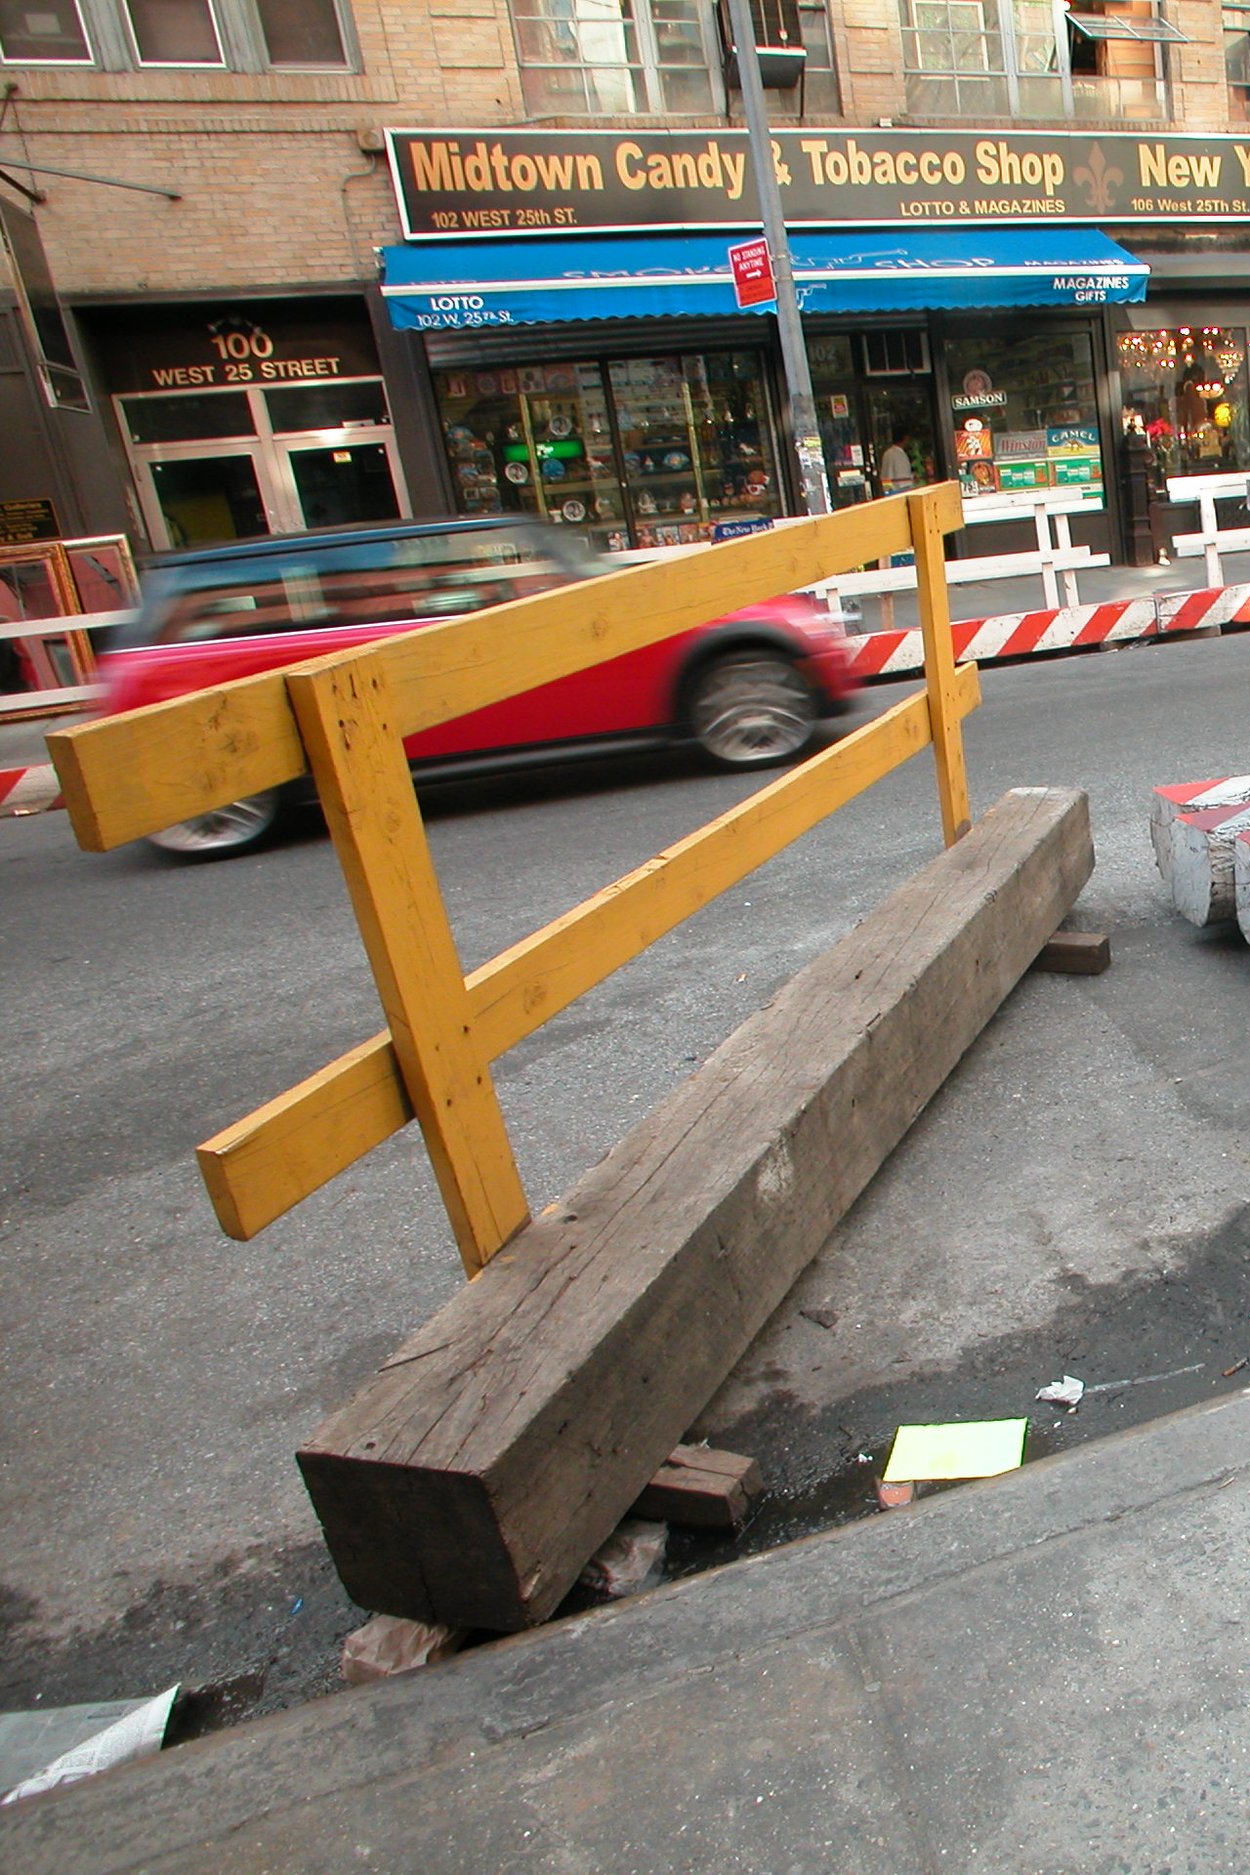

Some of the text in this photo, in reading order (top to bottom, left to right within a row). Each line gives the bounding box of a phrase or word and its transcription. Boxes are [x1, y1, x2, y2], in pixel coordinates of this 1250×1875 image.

[408, 139, 1065, 200] Midtown Candy & Tobacco Shop
[1138, 143, 1222, 188] New
[900, 199, 1066, 216] LOTTO & MAGAZINES
[1131, 198, 1250, 214] 106 West 25Th St.
[431, 207, 578, 229] 102 WEST 25th ST.
[732, 245, 766, 262] NO STANDING
[738, 257, 764, 271] ANYTIME
[1053, 276, 1129, 290] MAGAZINES
[430, 295, 484, 311] LOTTO
[1075, 290, 1106, 302] GIFTS
[416, 314, 441, 327] 102
[442, 313, 461, 326] W.
[210, 332, 273, 360] 100
[152, 357, 341, 387] WEST 25 STREET
[955, 392, 1003, 408] SAMSON
[1051, 429, 1096, 443] CAMEL
[1001, 436, 1046, 453] Winston
